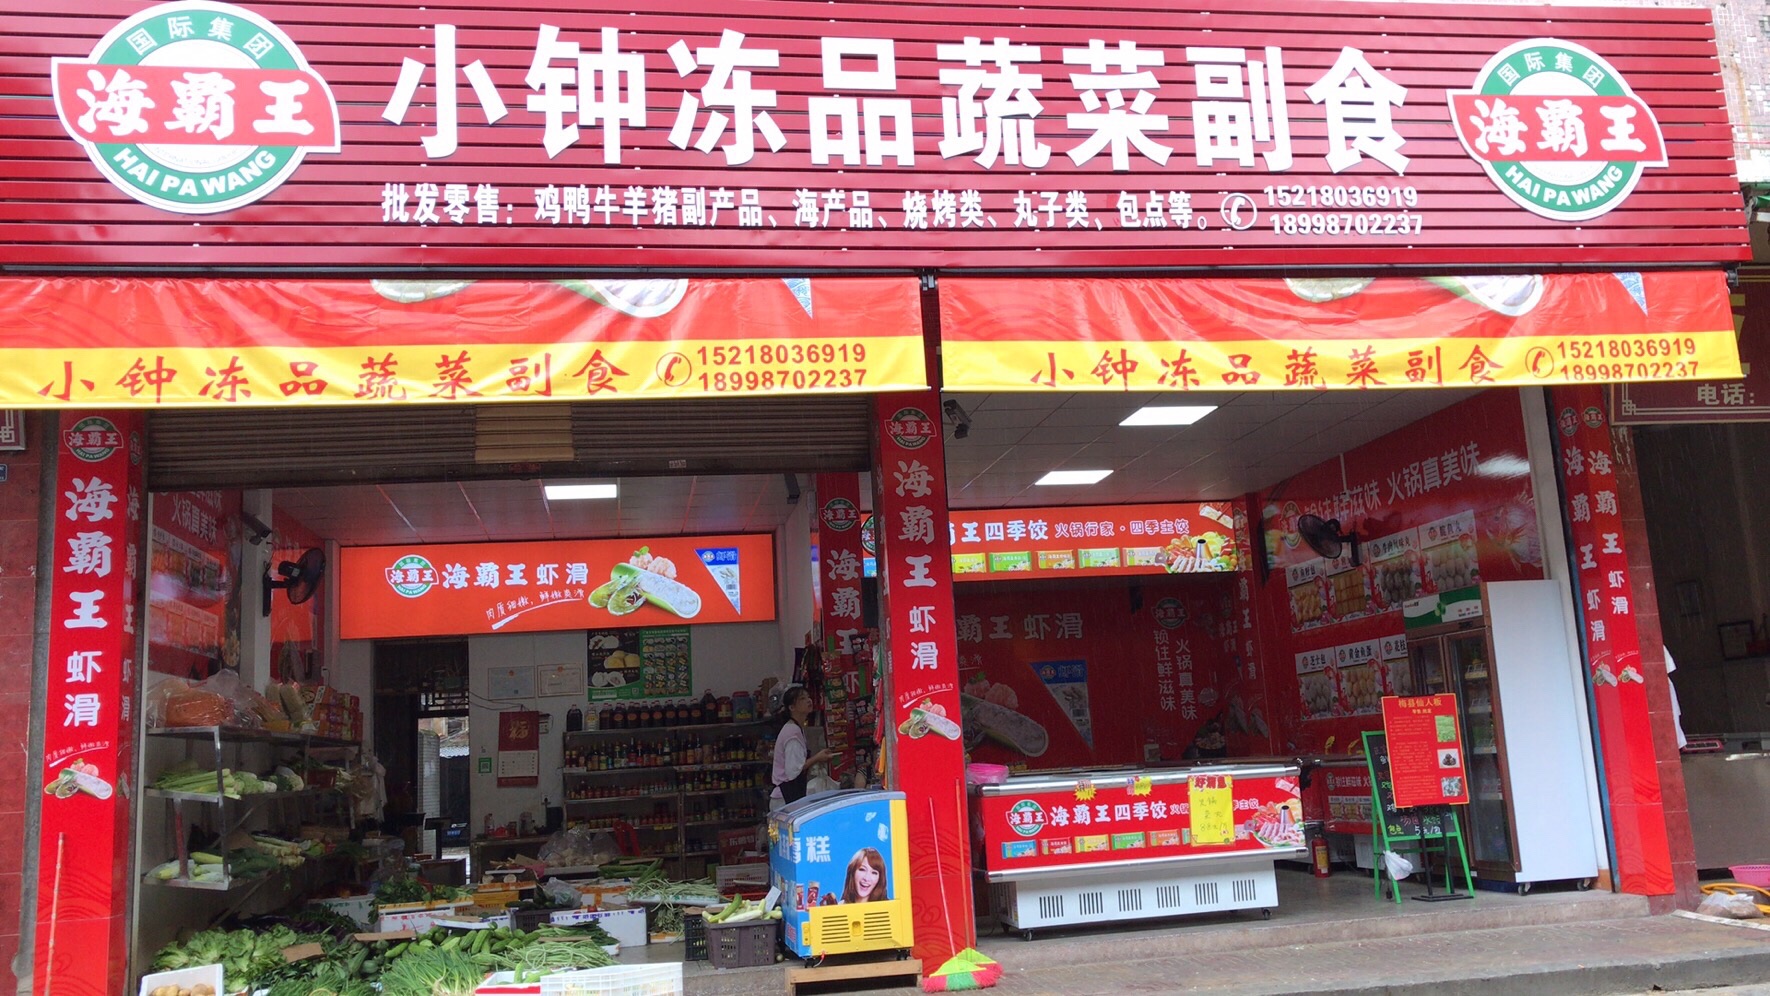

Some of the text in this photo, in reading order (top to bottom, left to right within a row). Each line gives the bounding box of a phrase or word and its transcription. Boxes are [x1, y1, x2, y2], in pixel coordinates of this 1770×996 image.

[126, 15, 276, 60] 国际集团
[1496, 50, 1606, 90] 国际集团
[75, 68, 316, 142] 海霸王
[381, 23, 1411, 176] 小钟冻品蔬菜副食
[1469, 97, 1648, 159] 海霸王
[113, 148, 158, 187] HAI
[160, 174, 199, 197] PA
[199, 149, 277, 197] WANG
[1503, 163, 1624, 206] HAI PA WANG
[1263, 185, 1419, 209] 15218036919
[1269, 213, 1424, 236] 18998702237
[696, 343, 867, 367] 15218036919
[1030, 345, 1505, 392] 小钟冻品蔬菜副食
[1557, 337, 1697, 359] 15218036919
[37, 347, 629, 406] 小钟冻品蔬菜副食
[698, 368, 868, 393] 18998702237
[1559, 359, 1699, 382] 18998702237
[68, 431, 119, 447] 海霸王
[889, 420, 932, 436] 海霸王
[1386, 440, 1482, 506] 火锅真美味
[1564, 446, 1606, 643] 海霸王虾滑
[1586, 450, 1629, 615] 海霸王虾滑
[389, 569, 435, 584] 海霸王
[442, 561, 589, 590] 海霸王虾滑
[893, 459, 940, 671] 海霸王虾滑
[62, 476, 118, 728] 海霸王虾滑
[1175, 638, 1198, 721] 火锅真美味
[1009, 812, 1046, 825] 海霸王
[1050, 801, 1168, 828] 海霸王四季饺
